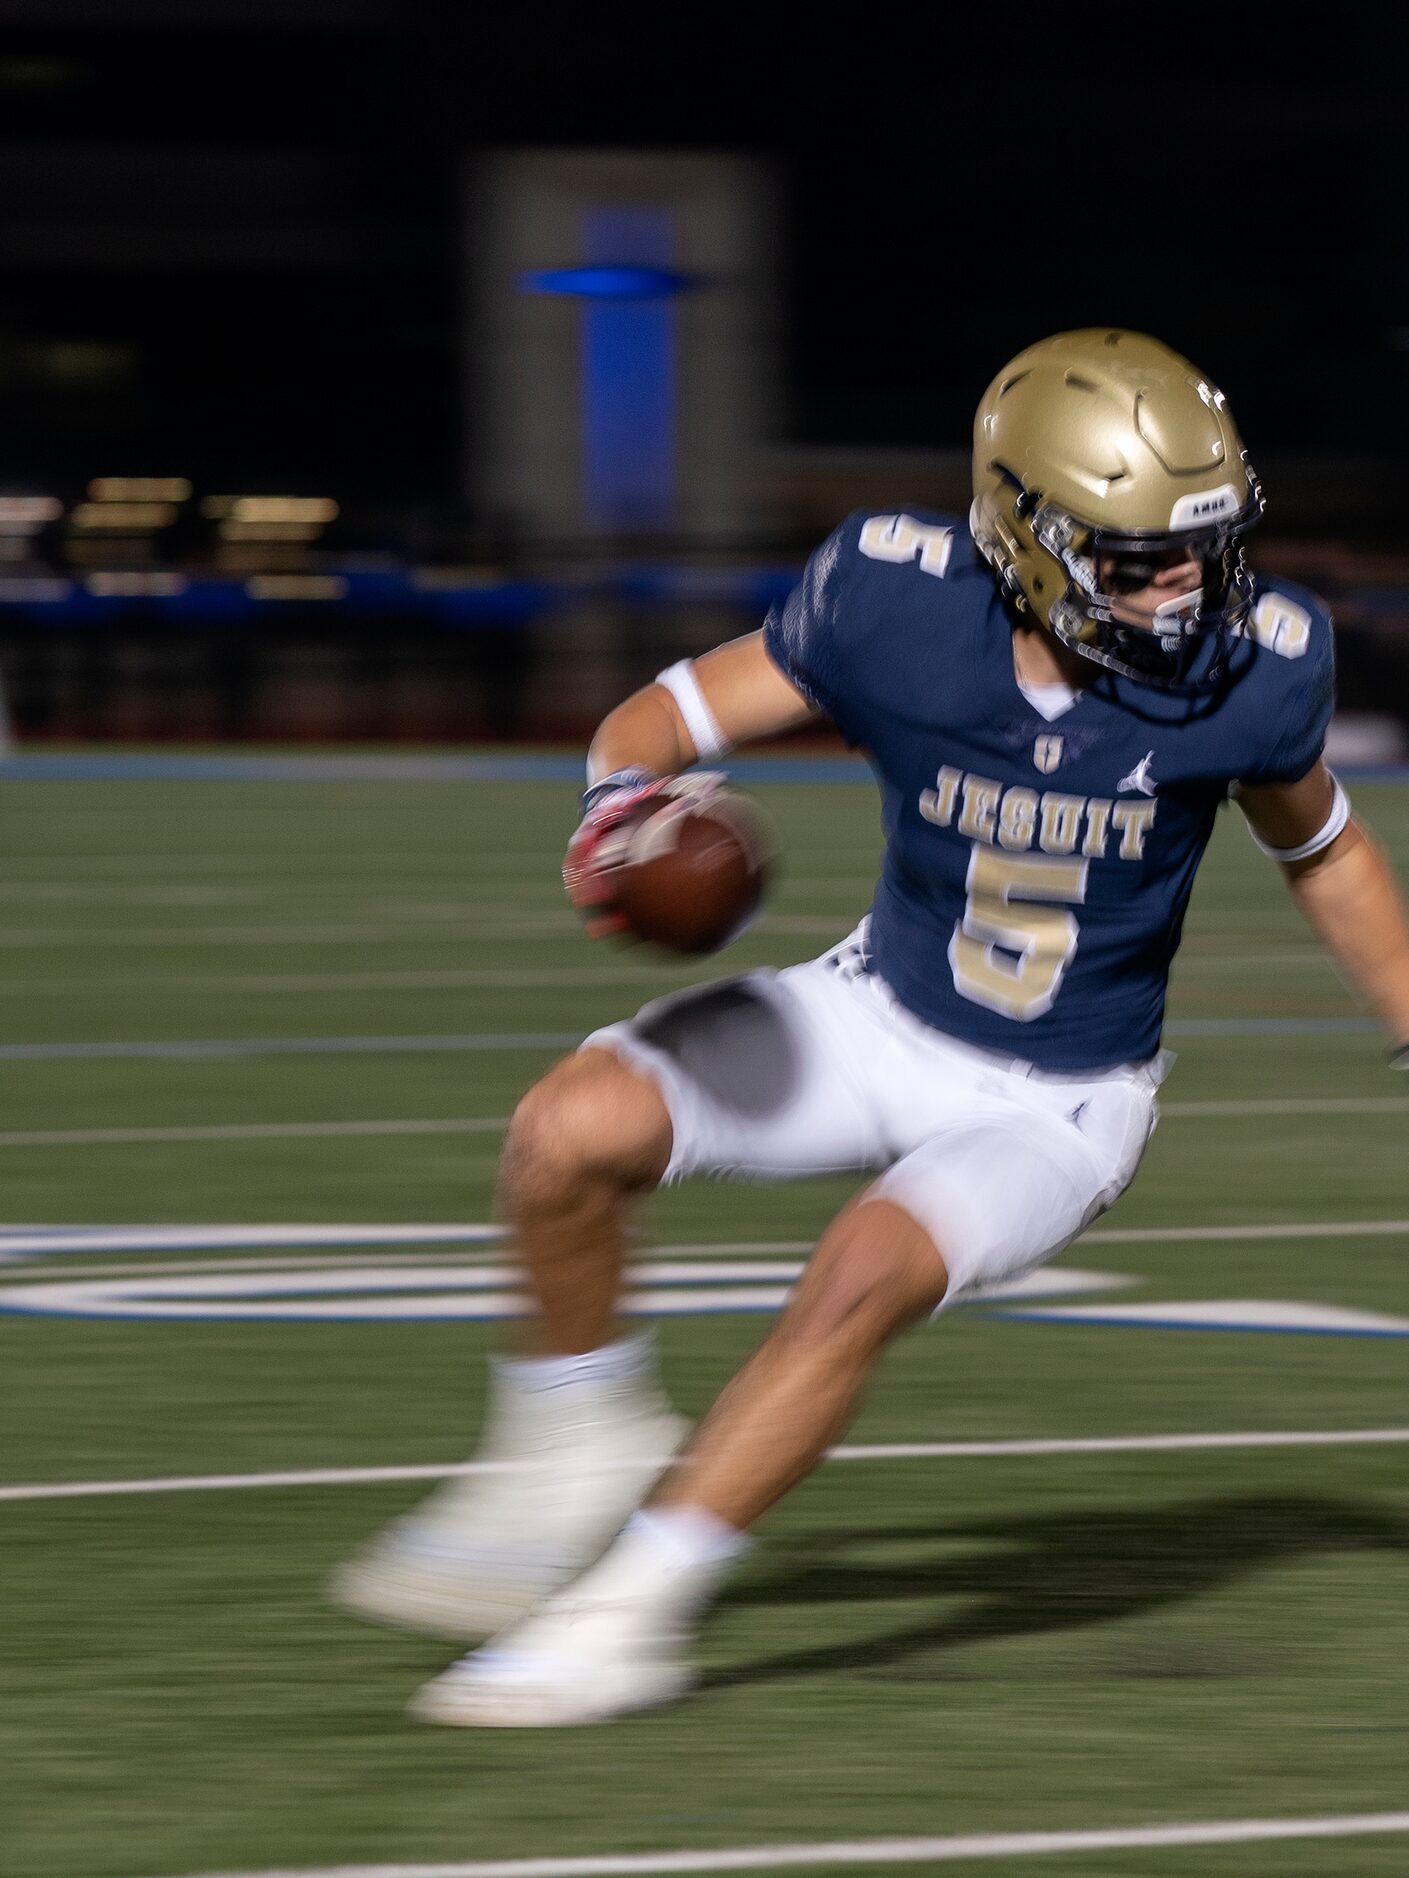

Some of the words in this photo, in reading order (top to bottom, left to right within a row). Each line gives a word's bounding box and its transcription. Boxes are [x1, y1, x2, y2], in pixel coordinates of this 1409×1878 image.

[858, 513, 954, 579] 5
[919, 765, 1156, 859] JESUIT
[949, 842, 1086, 1022] 5
